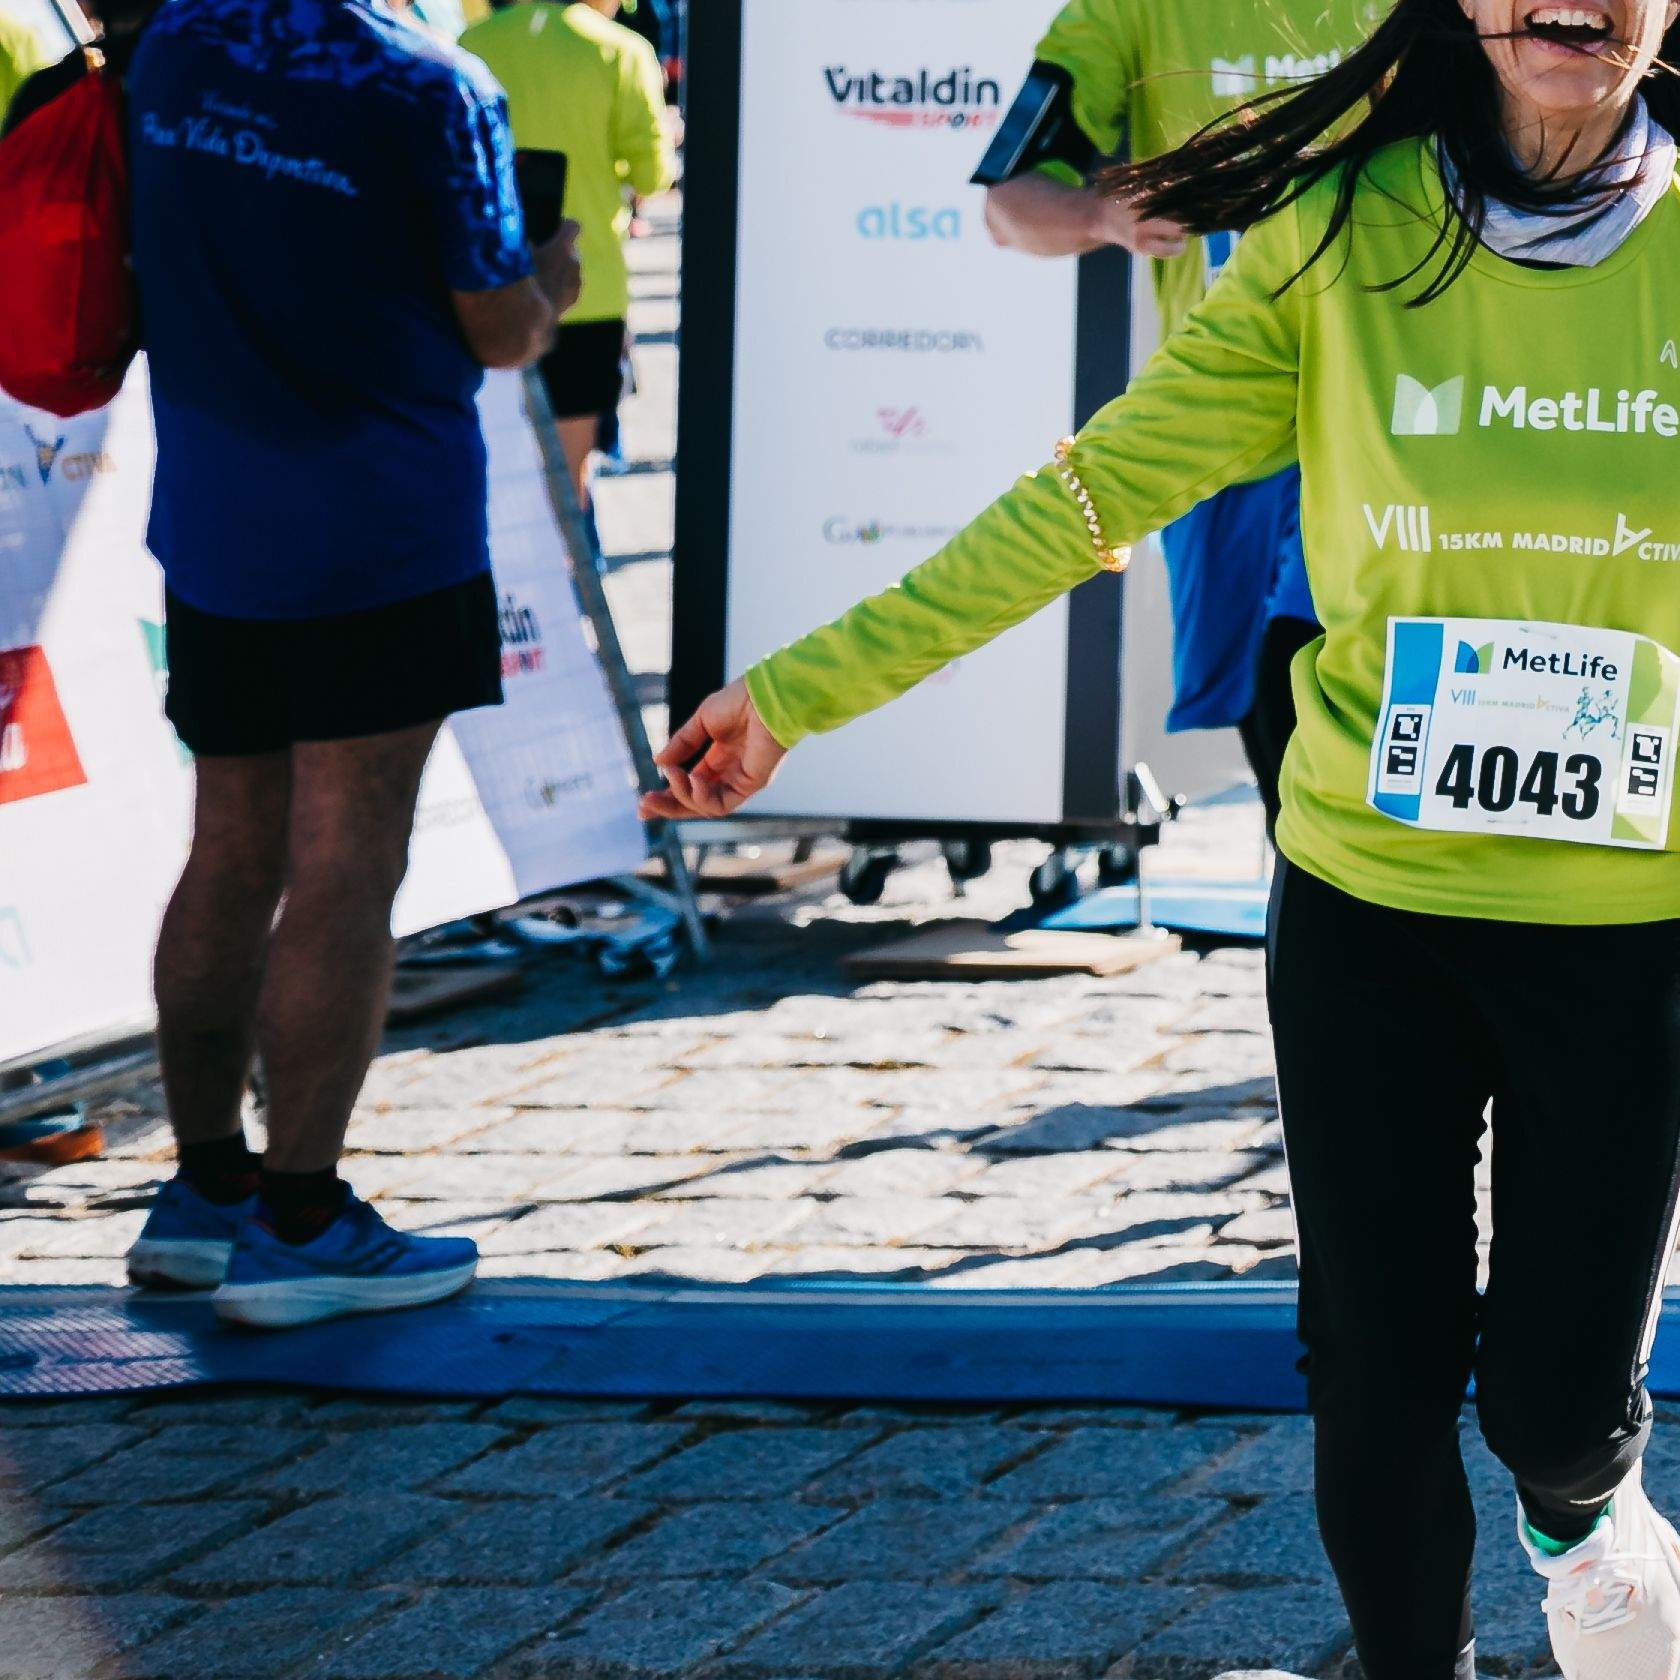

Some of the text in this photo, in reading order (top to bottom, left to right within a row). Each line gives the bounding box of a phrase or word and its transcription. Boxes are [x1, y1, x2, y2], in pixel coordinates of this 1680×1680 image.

[823, 65, 1000, 105] Vitaldin
[856, 204, 963, 241] alsa
[1479, 385, 1680, 438] MetLife
[1362, 504, 1432, 553] VIII
[1439, 532, 1503, 550] 15KM
[1512, 532, 1611, 557] MADRID
[1502, 647, 1619, 682] MetLife
[1435, 743, 1602, 820] 4043
